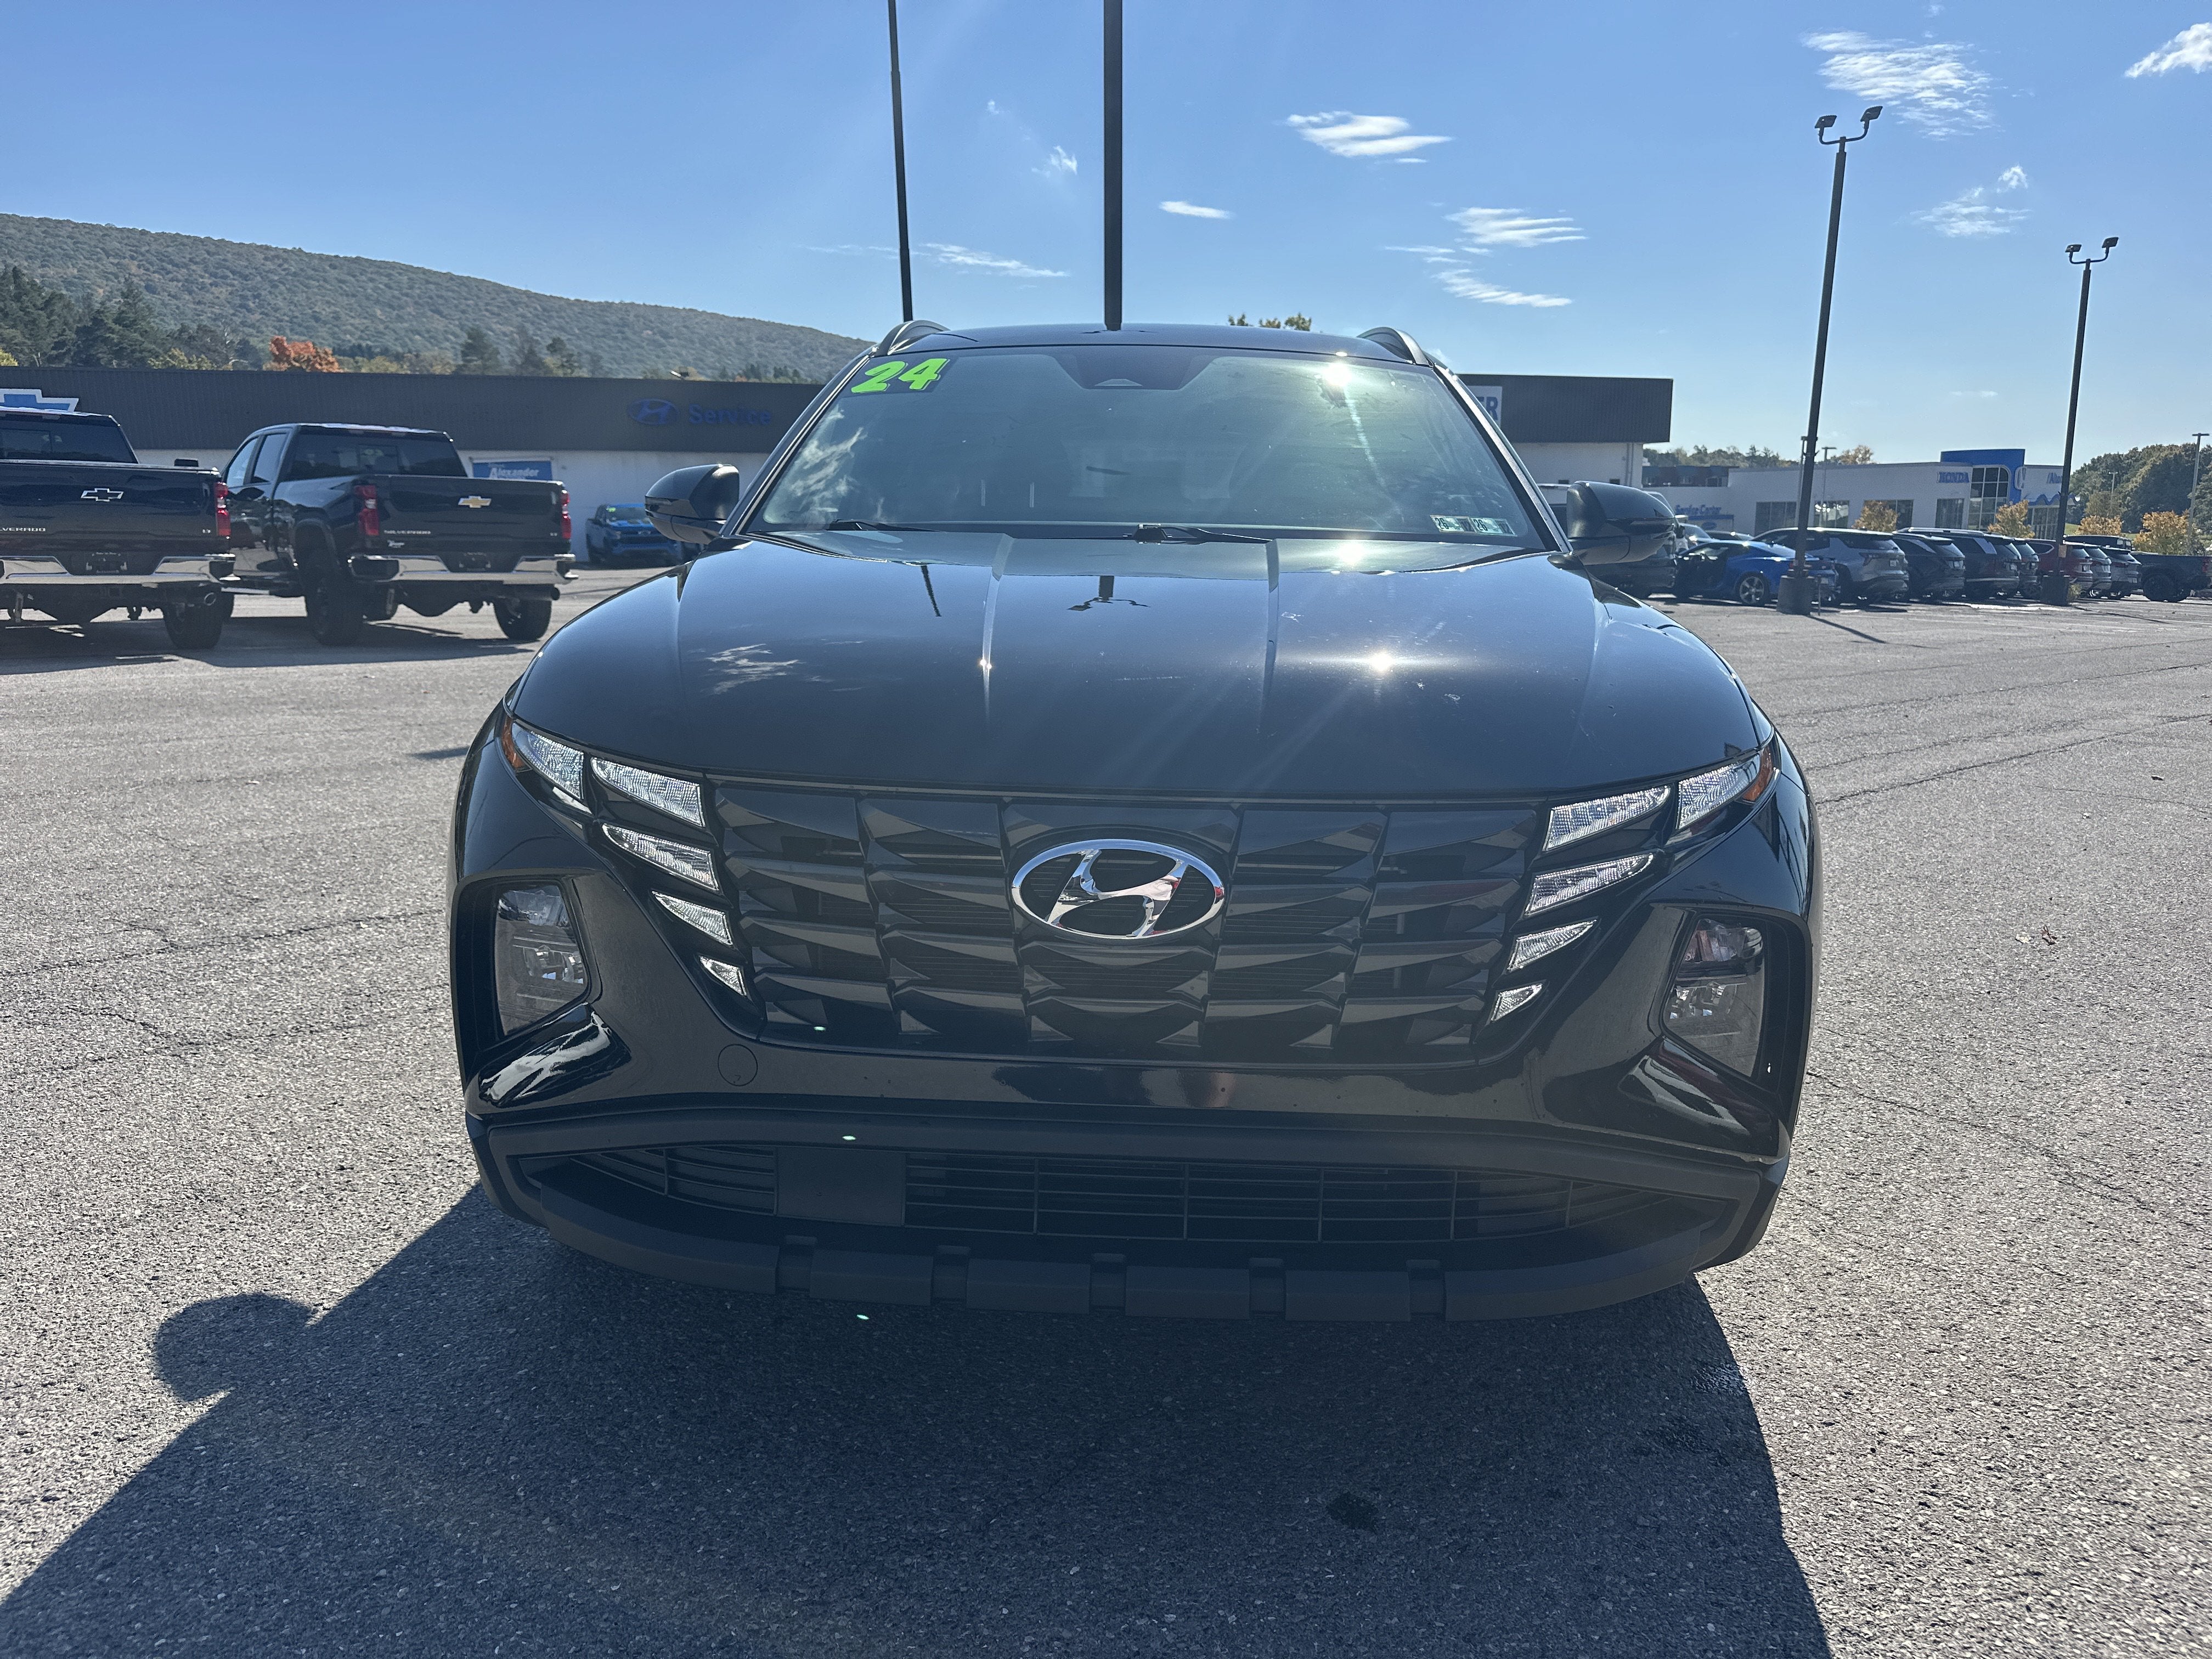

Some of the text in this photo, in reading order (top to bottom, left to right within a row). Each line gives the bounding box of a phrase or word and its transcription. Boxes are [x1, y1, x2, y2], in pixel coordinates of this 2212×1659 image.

[851, 358, 950, 393] 24
[689, 403, 771, 425] Service
[1476, 397, 1498, 421] R
[489, 467, 539, 478] Alexander
[1938, 471, 1970, 483] HONDA
[1435, 517, 1449, 529] 26
[1473, 518, 1488, 531] 26
